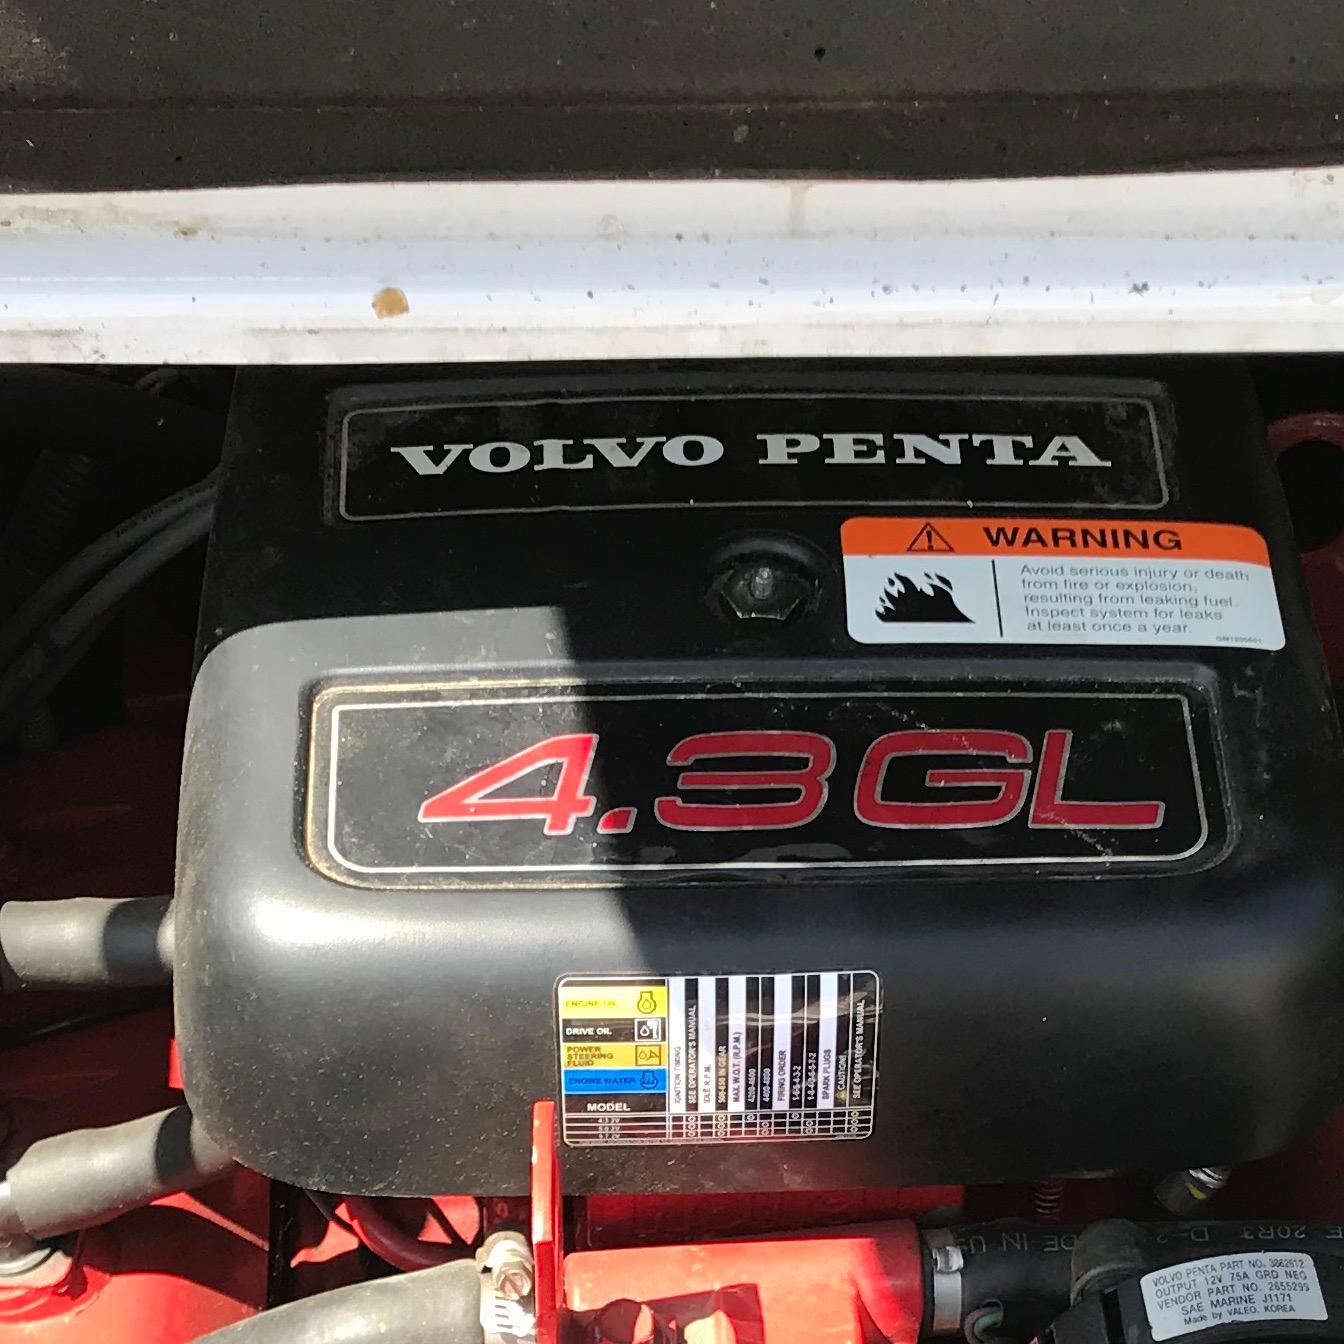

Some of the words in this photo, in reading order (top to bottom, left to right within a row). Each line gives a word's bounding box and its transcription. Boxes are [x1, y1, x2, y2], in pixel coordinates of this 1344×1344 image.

[391, 434, 724, 476] VOLVO
[757, 433, 1111, 467] PENTA
[983, 527, 1182, 551] WARNING
[1021, 565, 1064, 576] Avoid
[1070, 566, 1129, 577] serious
[1134, 567, 1178, 579] injury
[1204, 568, 1249, 581] death
[1022, 579, 1058, 590] from
[1064, 580, 1089, 590] fire
[1094, 582, 1110, 590] or
[1024, 592, 1093, 606] resulting
[1098, 593, 1135, 604] from
[1140, 594, 1199, 607] leaking
[1026, 605, 1085, 619] Inspect
[1090, 608, 1148, 620] system
[1154, 608, 1174, 619] for
[1180, 609, 1223, 621] leaks
[1027, 620, 1042, 632] at
[1048, 620, 1087, 632] least
[1092, 622, 1132, 632] once
[1137, 624, 1147, 633] a
[1153, 624, 1192, 635] year.
[417, 729, 1164, 836] 4.3GL
[688, 1004, 696, 1040] MANUAL
[856, 1000, 865, 1035] MANUAL
[566, 1027, 594, 1036] DRIVE
[596, 1027, 612, 1036] OIL
[688, 1041, 696, 1088] OPERATOR'S
[718, 1045, 726, 1067] GEAR
[778, 1049, 786, 1076] ORDER
[823, 1049, 831, 1074] PLUGS
[568, 1077, 602, 1085] ENGINE
[604, 1077, 635, 1085] WATER
[822, 1075, 830, 1100] SPARK
[853, 1084, 861, 1099] SEE
[586, 1103, 631, 1112] MODEL
[688, 1089, 696, 1104] SEE
[1000, 1232, 1027, 1251] IN
[1043, 1233, 1076, 1252] DE
[1152, 1270, 1182, 1287] VOLVO
[1186, 1264, 1217, 1279] PENTA
[1221, 1260, 1243, 1272] PART
[1155, 1280, 1197, 1299] OUTPUT
[1205, 1274, 1222, 1285] 12V
[1230, 1272, 1249, 1281] 75A
[1256, 1270, 1279, 1280] GRD
[1157, 1291, 1202, 1310] VENDOR
[1207, 1286, 1236, 1298] PART
[1181, 1302, 1204, 1316] SAE
[1210, 1296, 1255, 1309] MARINE
[1262, 1293, 1292, 1303] J1171
[1184, 1315, 1207, 1326] Made
[1212, 1311, 1222, 1321] by
[1264, 1304, 1296, 1313] KOREA
